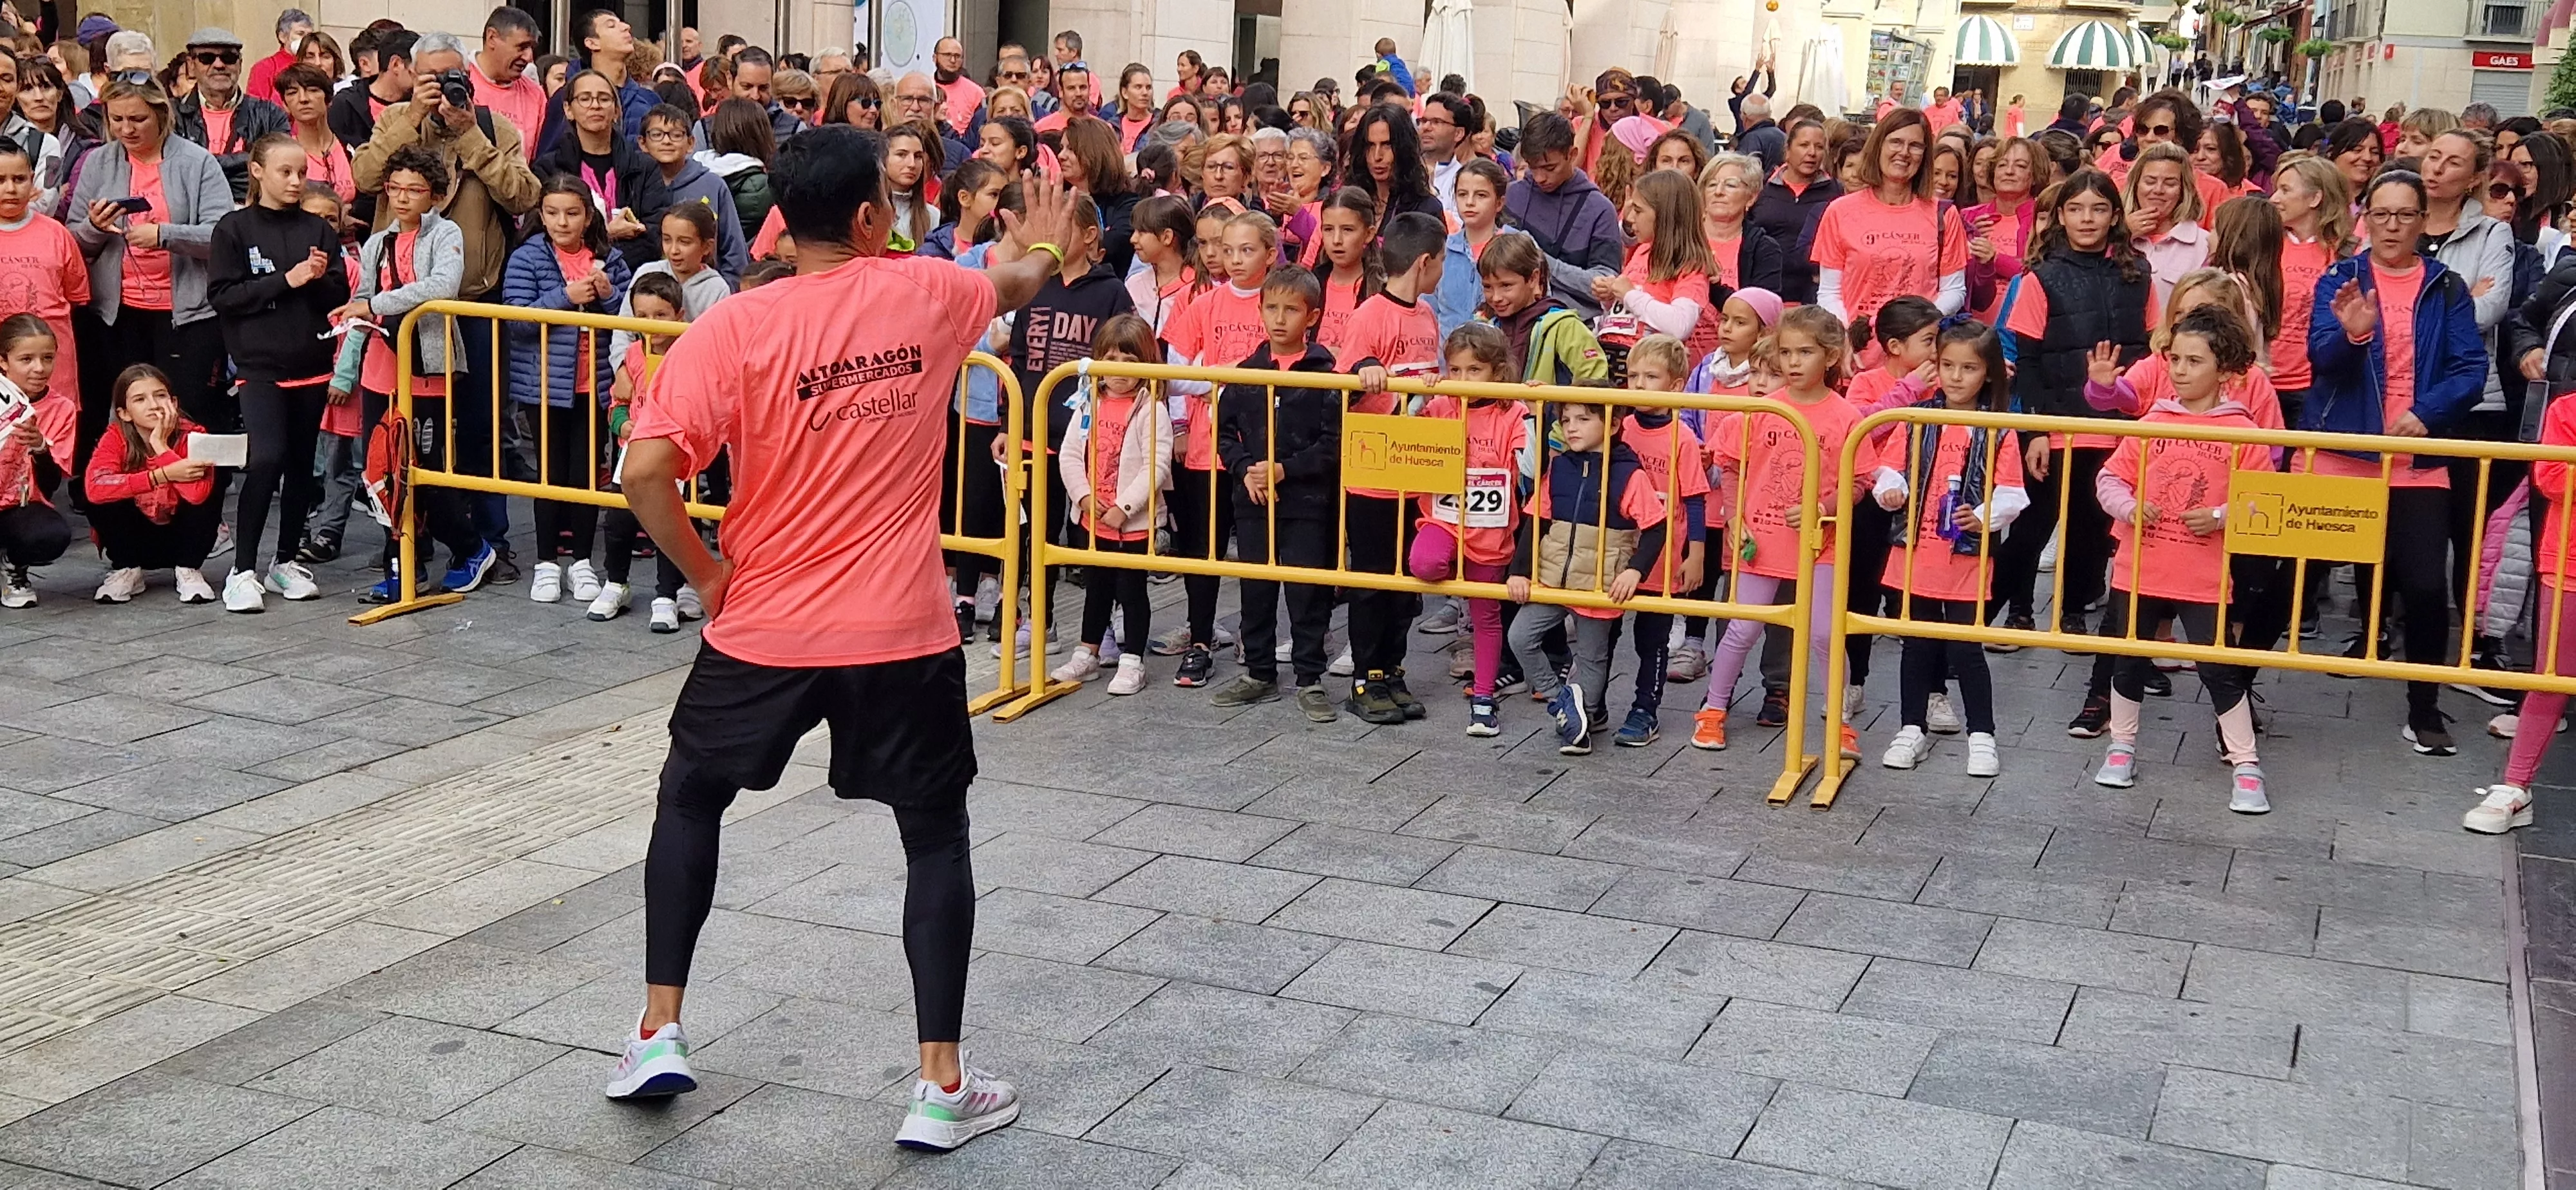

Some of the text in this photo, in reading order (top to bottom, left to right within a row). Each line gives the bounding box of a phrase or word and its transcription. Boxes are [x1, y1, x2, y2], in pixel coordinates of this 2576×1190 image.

[2490, 55, 2519, 66] GAES
[1052, 312, 1097, 344] DAY
[797, 343, 922, 387] ALTOARAGÓN
[837, 388, 918, 420] castellar
[1390, 440, 1461, 455] Ayuntamiento
[1390, 455, 1444, 467] de Huesca
[2288, 504, 2379, 519] Ayuntamiento
[2287, 519, 2355, 533] de Huesca
